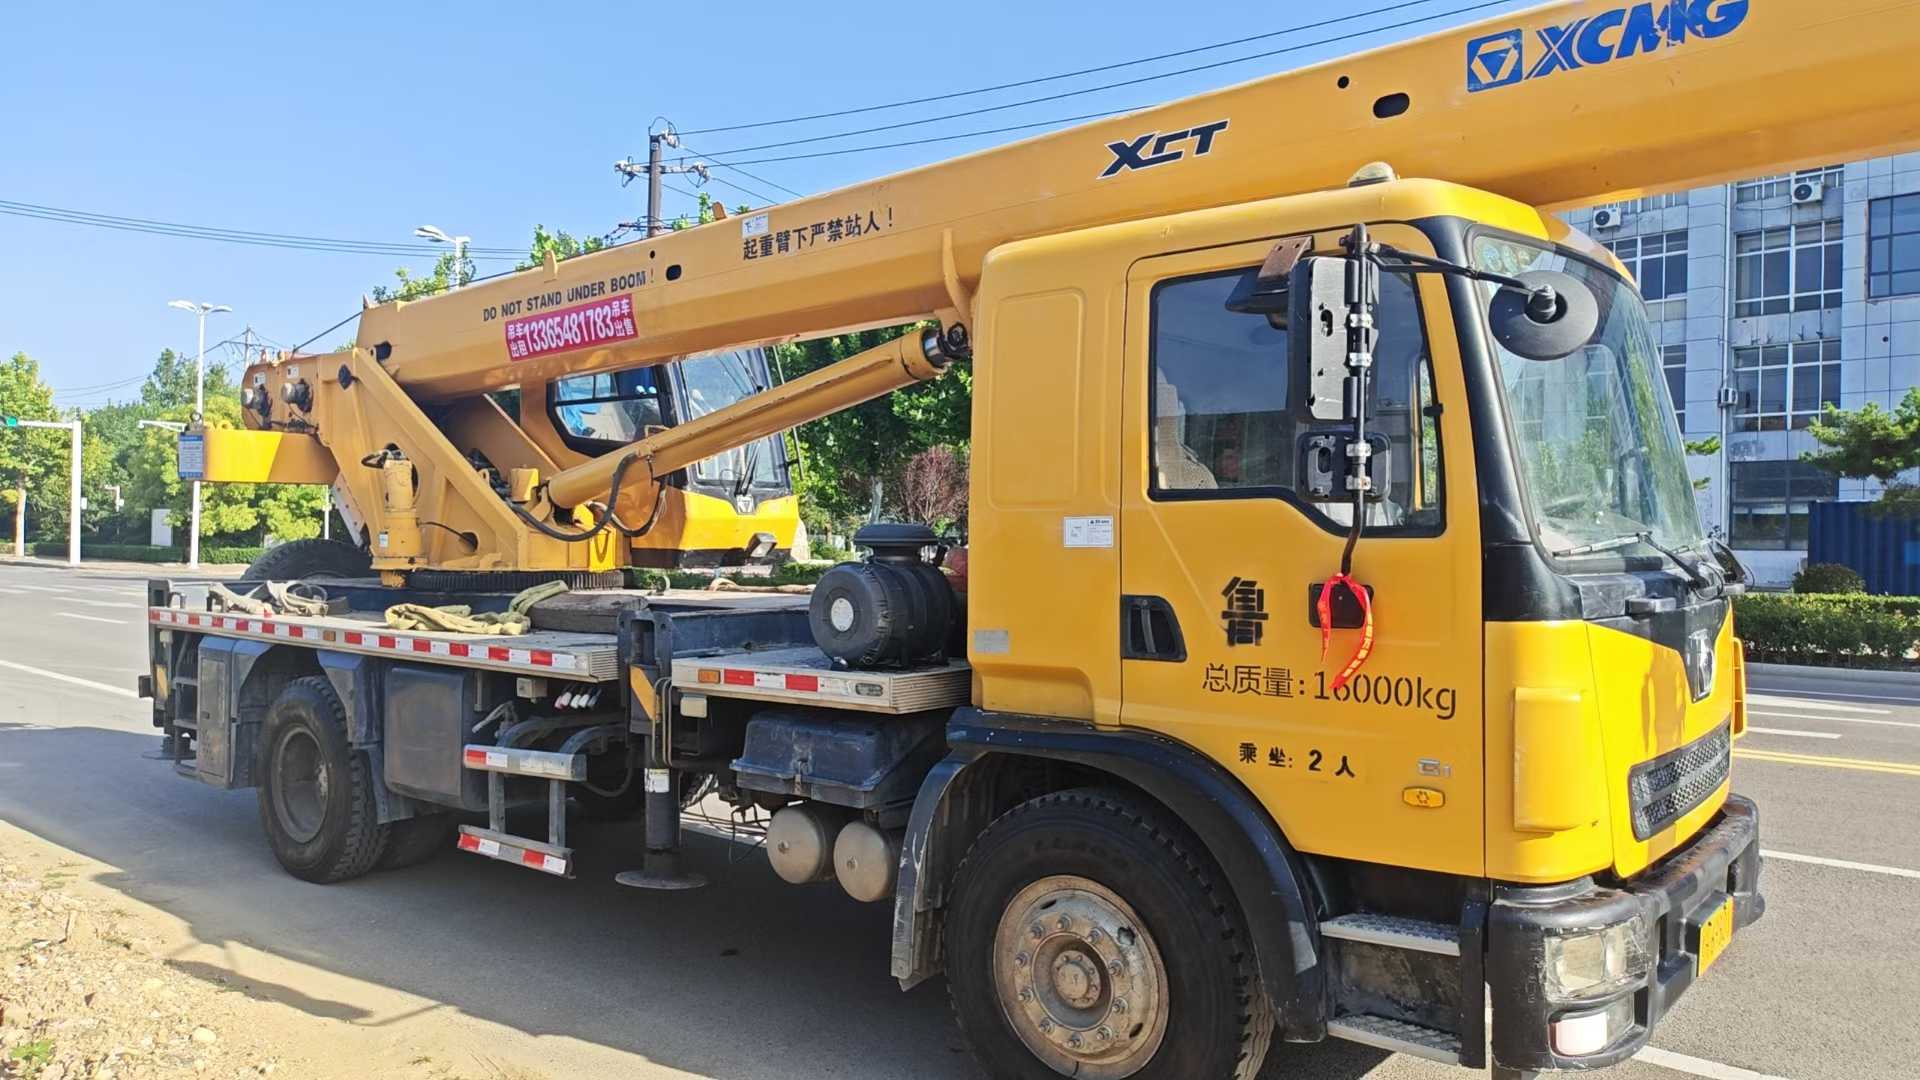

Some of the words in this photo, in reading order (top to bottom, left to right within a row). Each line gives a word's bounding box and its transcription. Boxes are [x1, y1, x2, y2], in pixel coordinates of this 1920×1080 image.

[1524, 0, 1749, 80] XCMG
[1096, 118, 1231, 180] XCT
[483, 308, 497, 322] DO
[501, 300, 523, 318] NOT
[526, 291, 562, 311] STAND
[567, 281, 606, 303] UNDER
[524, 304, 616, 354] 13365481783
[611, 298, 631, 318] 吊车
[1221, 576, 1269, 648] 鲁
